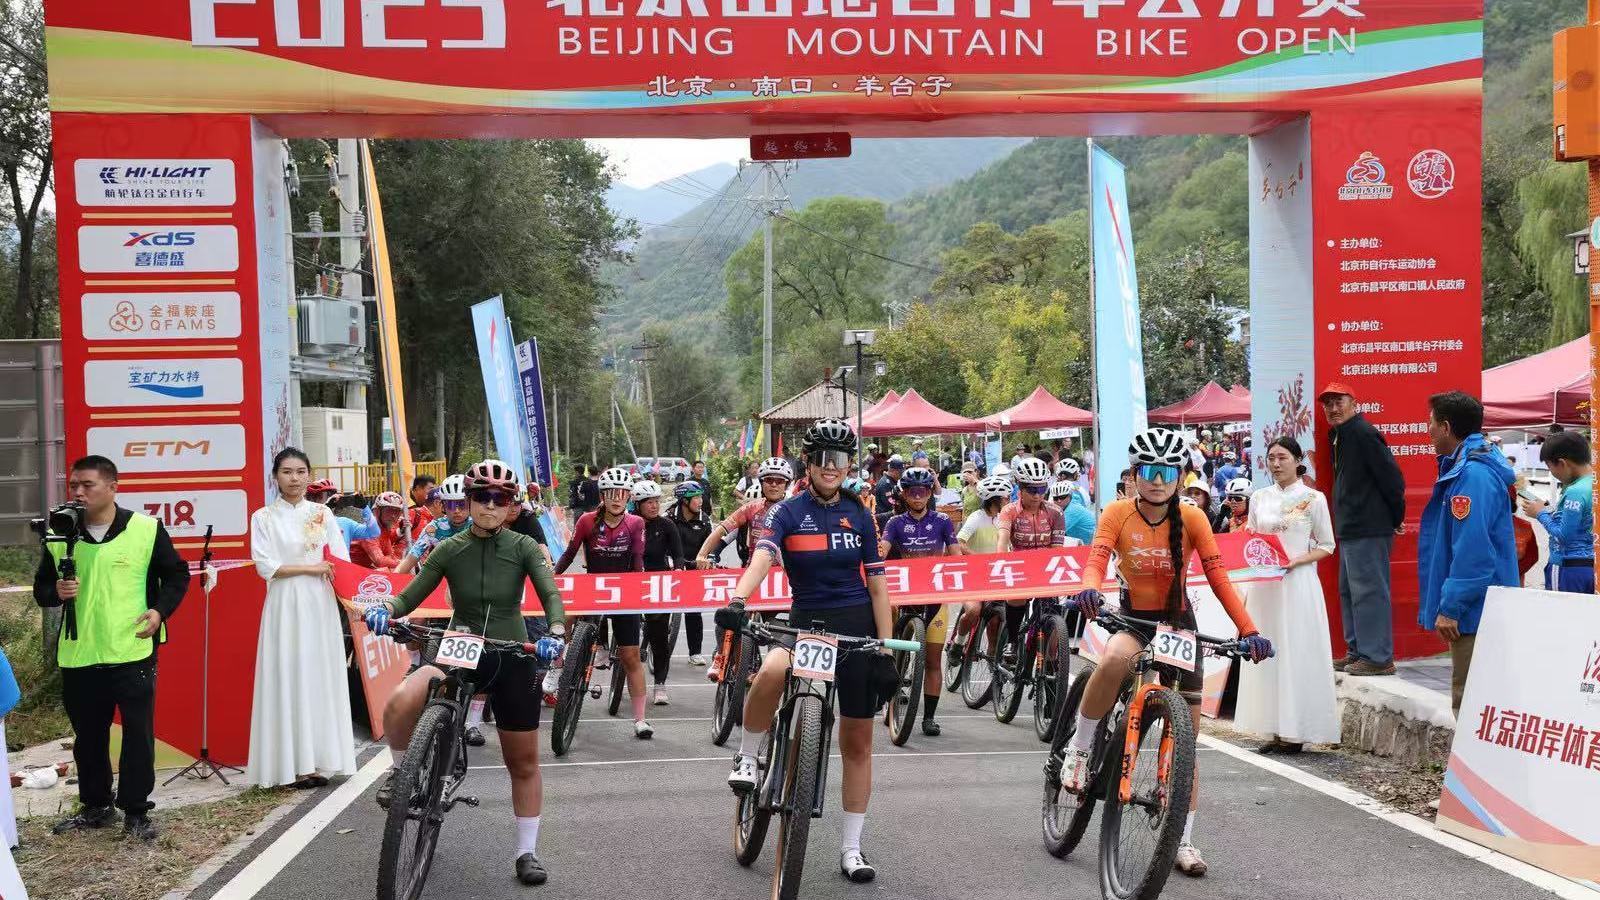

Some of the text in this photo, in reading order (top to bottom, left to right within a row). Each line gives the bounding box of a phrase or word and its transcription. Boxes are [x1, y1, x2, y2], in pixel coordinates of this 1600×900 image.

[558, 27, 1356, 56] BEIJING MOUNTAIN BIKE OPEN
[105, 188, 206, 199] 航轮钛合金自行车
[1340, 238, 1383, 249] 主办单位:
[135, 252, 185, 267] 喜德盛
[1340, 258, 1437, 271] 北京市自行车运动协会
[1340, 279, 1466, 293] 北京市昌平区南口镇人民政府
[150, 304, 215, 318] 全福鞍座
[150, 318, 216, 331] QFAMS
[1341, 320, 1385, 332] 协办单位:
[1341, 340, 1463, 354] 北京市昌平区南口镇羊台子村委会
[1341, 362, 1438, 376] 北京沿岸体育有限公司
[129, 370, 201, 384] 宝矿力水特
[123, 440, 210, 457] ETM
[441, 638, 479, 661] 386
[1158, 633, 1193, 661] 378
[797, 643, 834, 671] 379
